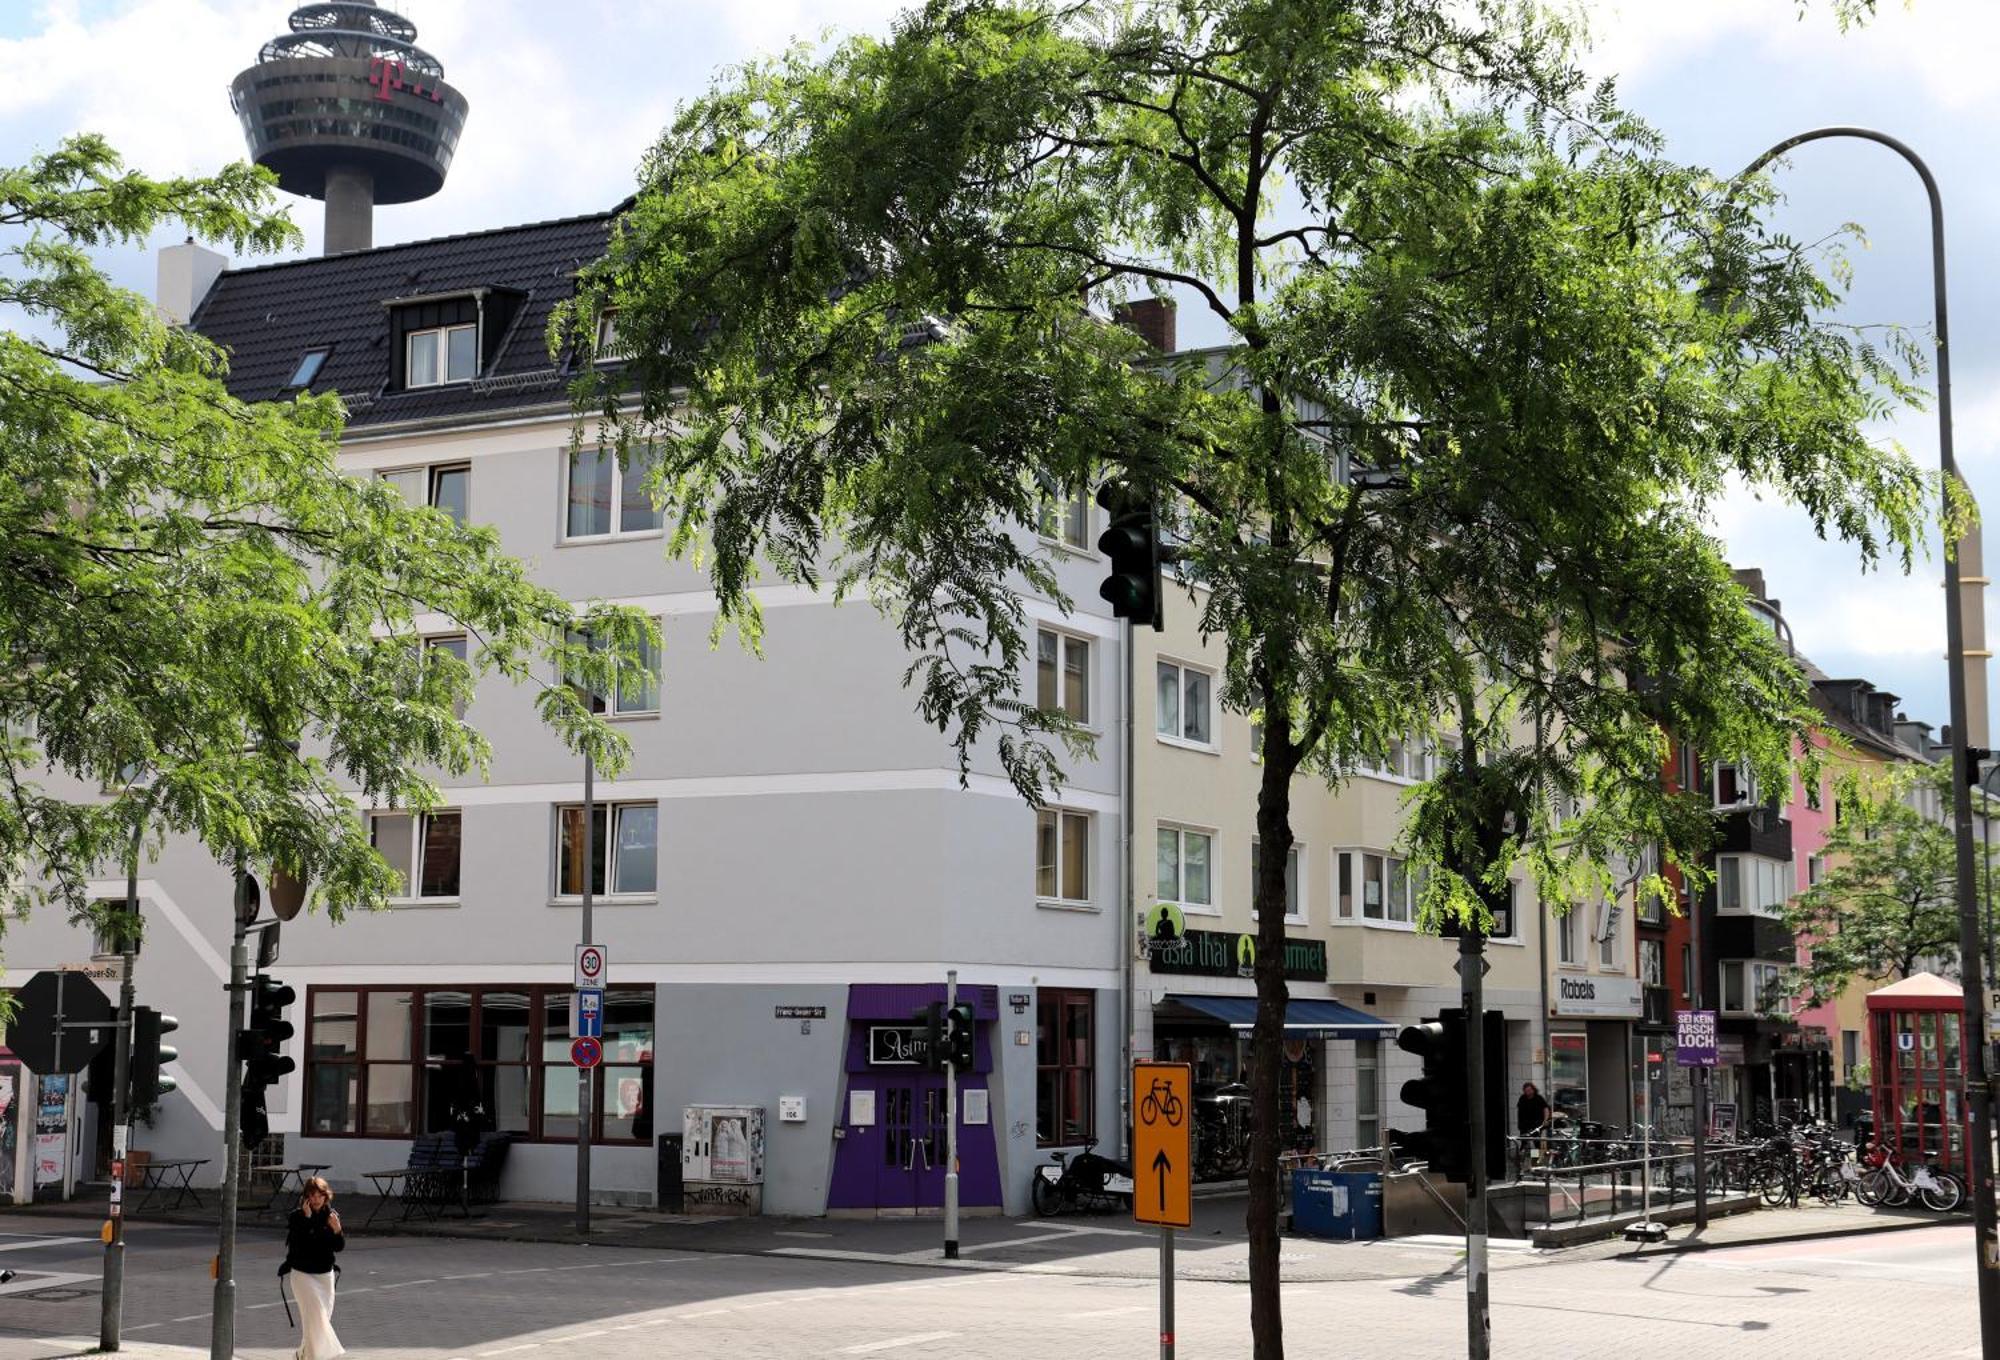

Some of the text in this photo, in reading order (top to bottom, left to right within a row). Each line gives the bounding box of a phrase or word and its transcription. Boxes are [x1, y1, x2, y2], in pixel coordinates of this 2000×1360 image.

[1199, 931, 1228, 968] thai
[584, 956, 597, 969] 30
[582, 978, 598, 986] ZONE
[1678, 1014, 1714, 1024] SEI KEIN
[1678, 1024, 1714, 1034] ARSCH
[1678, 1034, 1715, 1048] LOCH
[1899, 1034, 1914, 1050] U
[1921, 1034, 1935, 1050] U
